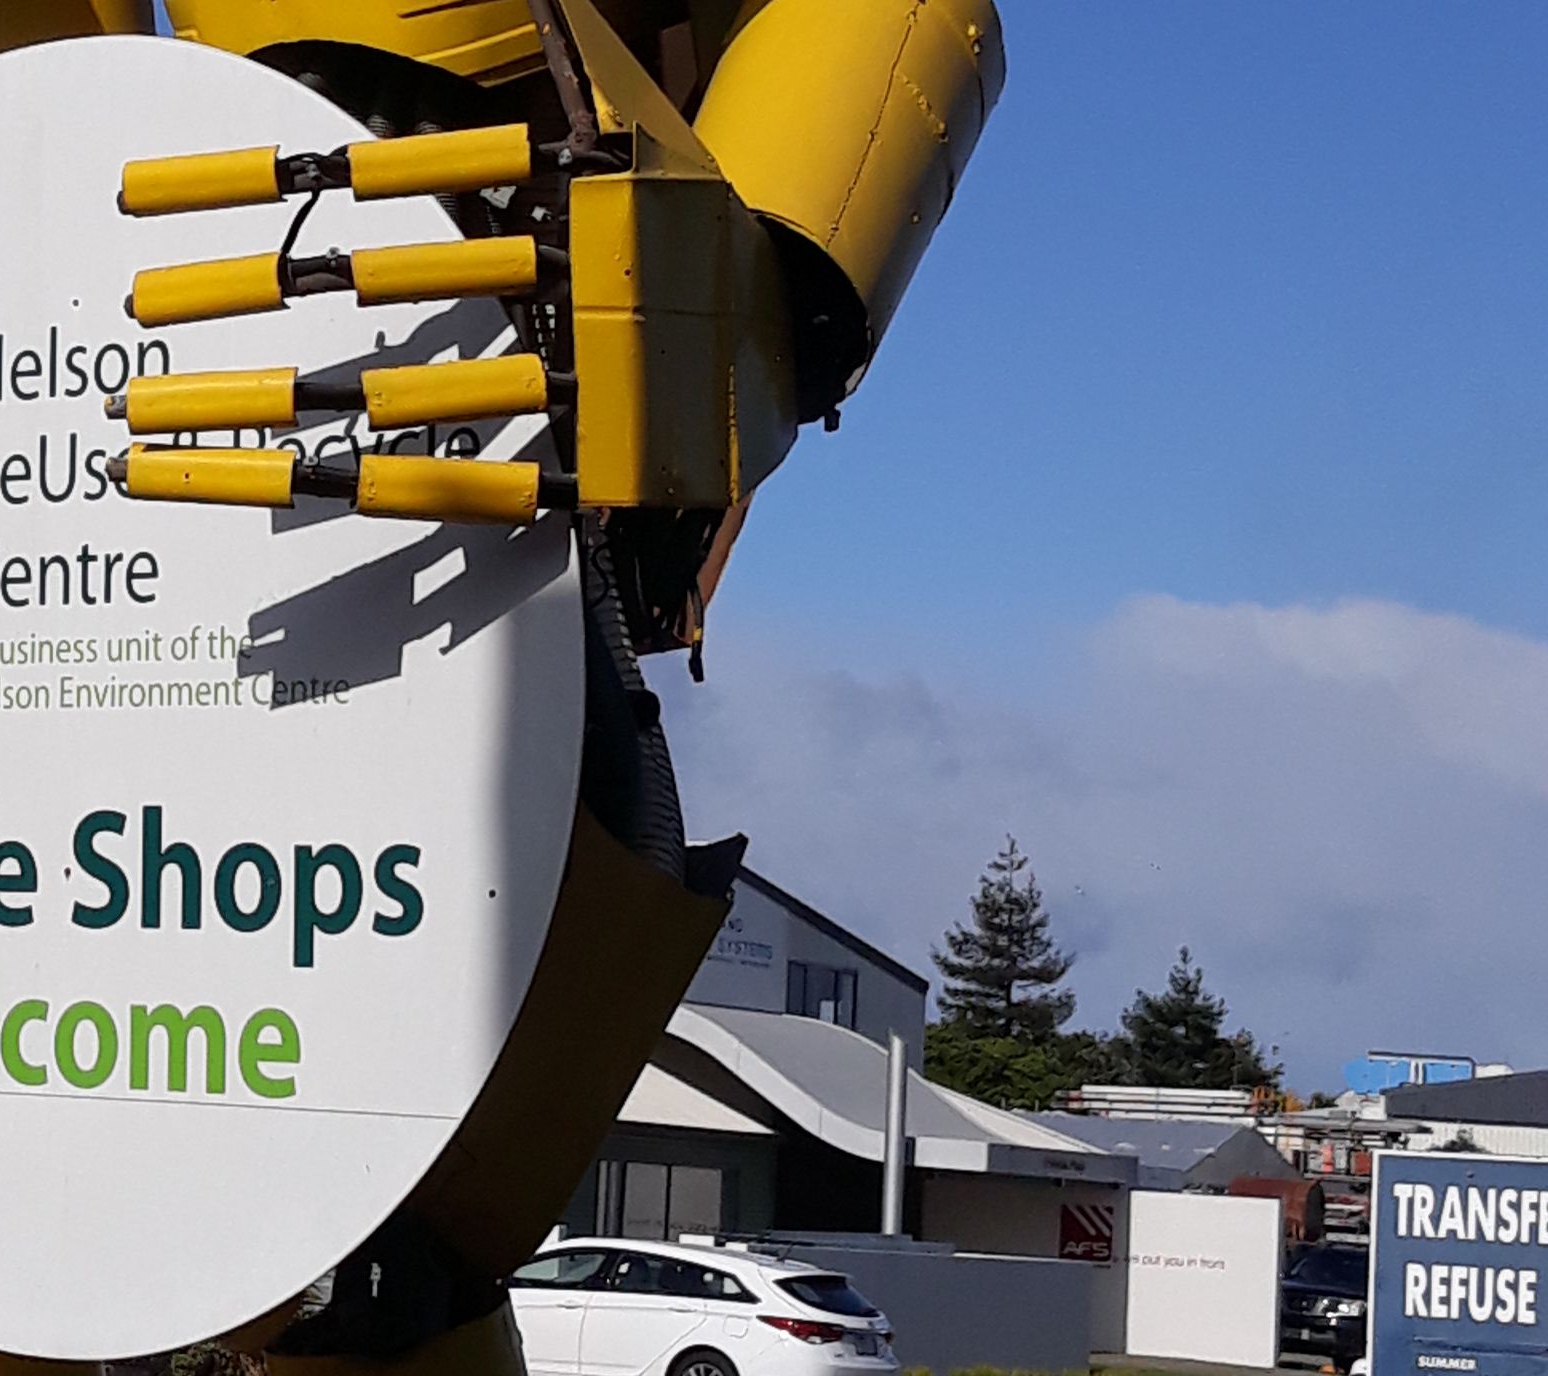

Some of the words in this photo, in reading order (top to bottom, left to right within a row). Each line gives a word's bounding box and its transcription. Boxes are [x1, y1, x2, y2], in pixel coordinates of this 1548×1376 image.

[108, 629, 163, 663] unit
[171, 625, 202, 661] of
[207, 625, 254, 660] the
[59, 675, 243, 709] Environment
[251, 671, 351, 706] Centre
[70, 804, 425, 968] Shops
[1062, 1240, 1110, 1258] AFS
[1404, 1262, 1538, 1325] REFUSE
[1417, 1355, 1476, 1371] SUMMER
